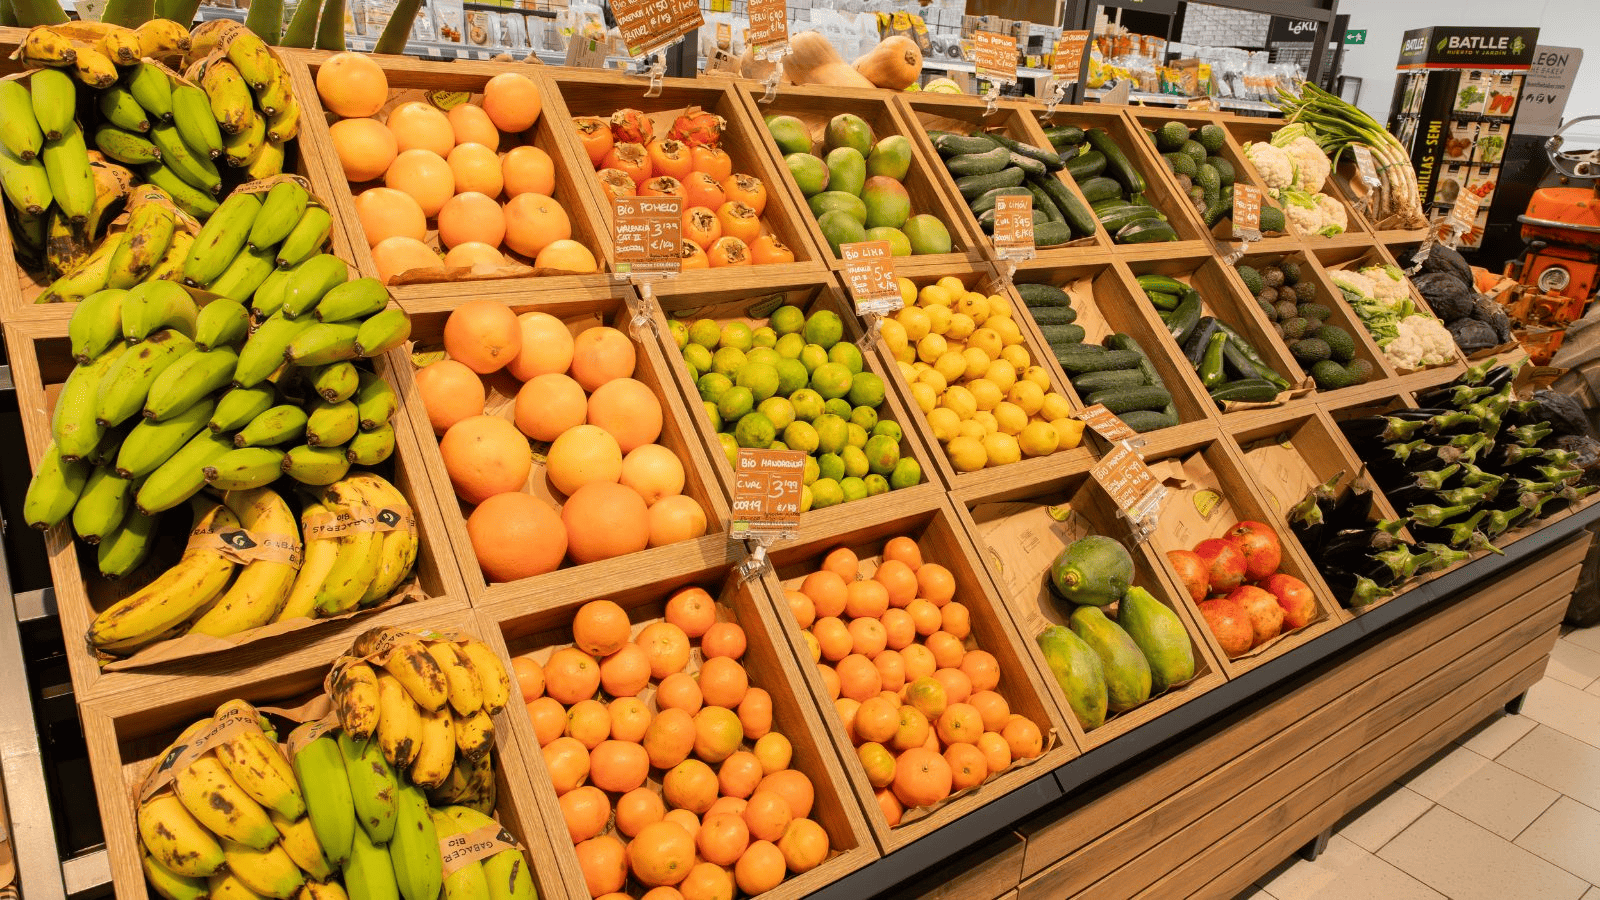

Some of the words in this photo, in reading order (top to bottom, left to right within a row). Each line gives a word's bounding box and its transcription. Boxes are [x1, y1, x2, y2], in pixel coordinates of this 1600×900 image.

[1405, 38, 1424, 49] BATLLE
[1448, 36, 1509, 49] BATLLE
[1533, 53, 1569, 67] EON
[1426, 120, 1443, 146] SEMI
[640, 203, 679, 213] POMELO
